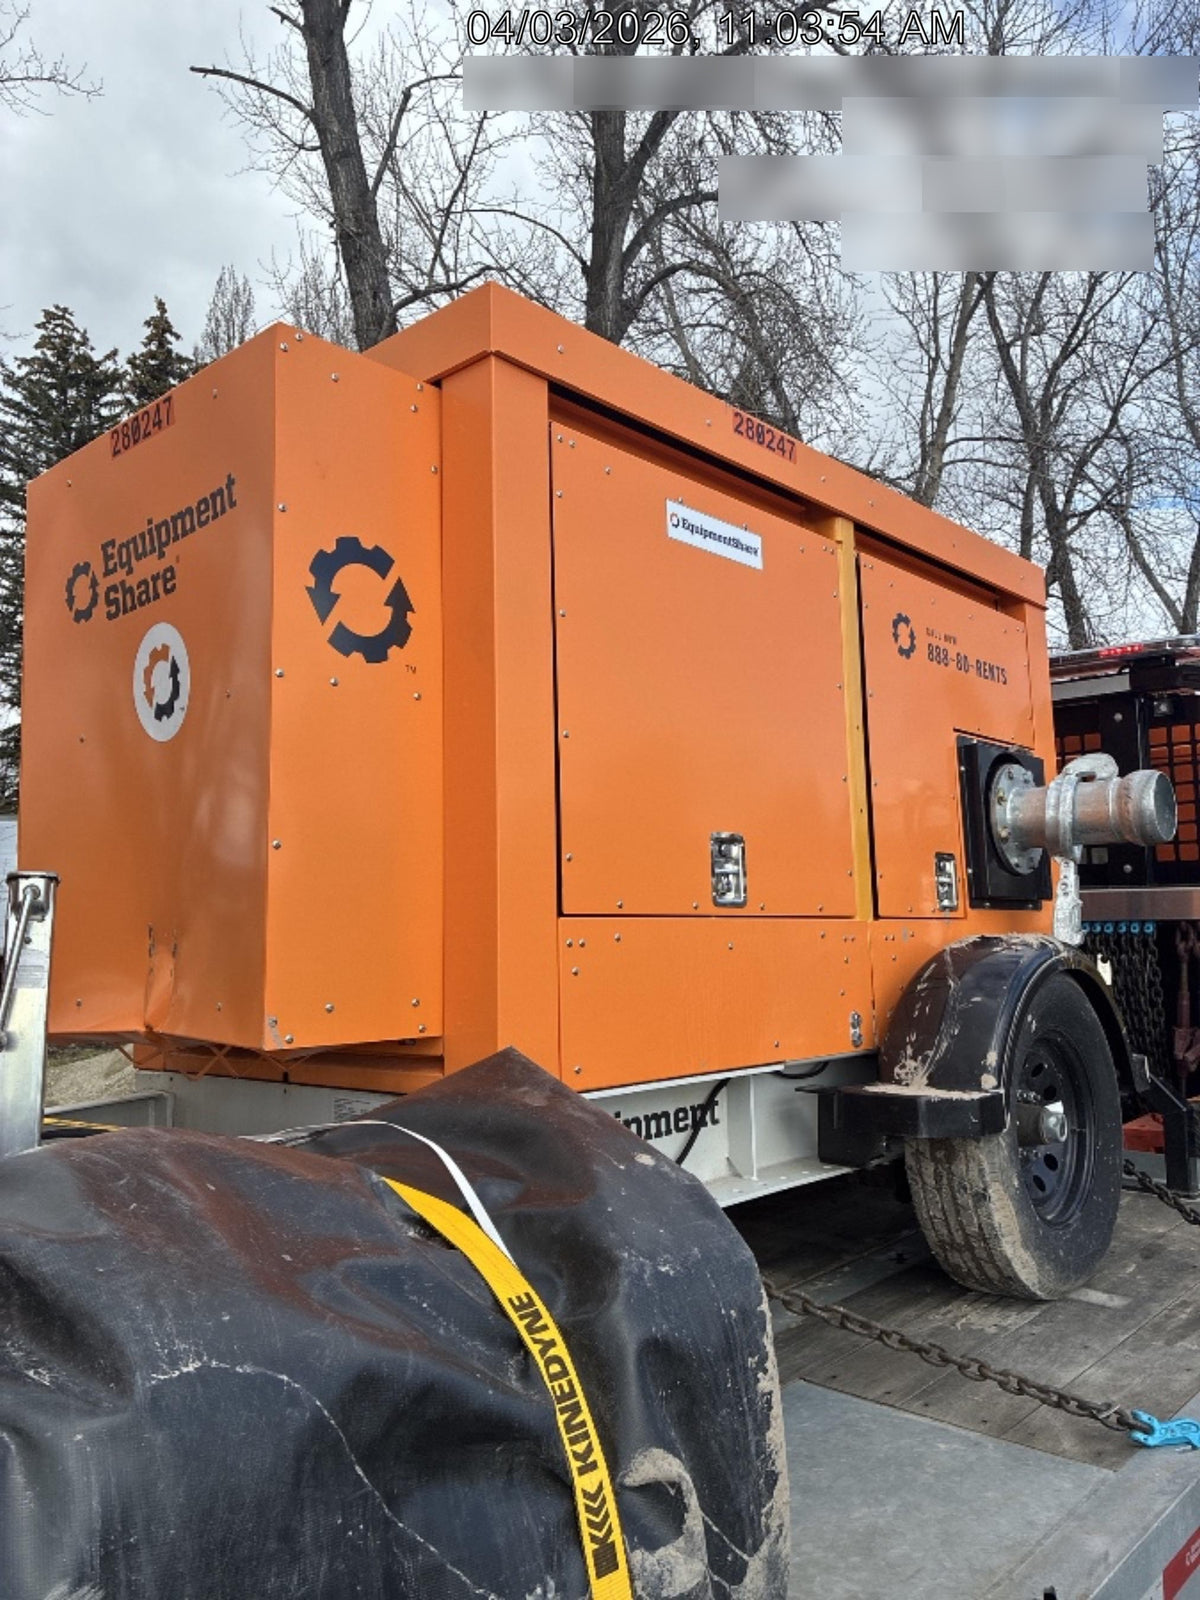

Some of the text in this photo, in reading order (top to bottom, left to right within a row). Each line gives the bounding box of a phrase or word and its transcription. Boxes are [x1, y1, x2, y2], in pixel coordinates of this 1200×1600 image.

[110, 396, 173, 458] 280247
[733, 411, 796, 461] 280247
[101, 472, 237, 578] Equipment
[104, 565, 177, 621] Share
[508, 1291, 599, 1477] KINEDYNE
